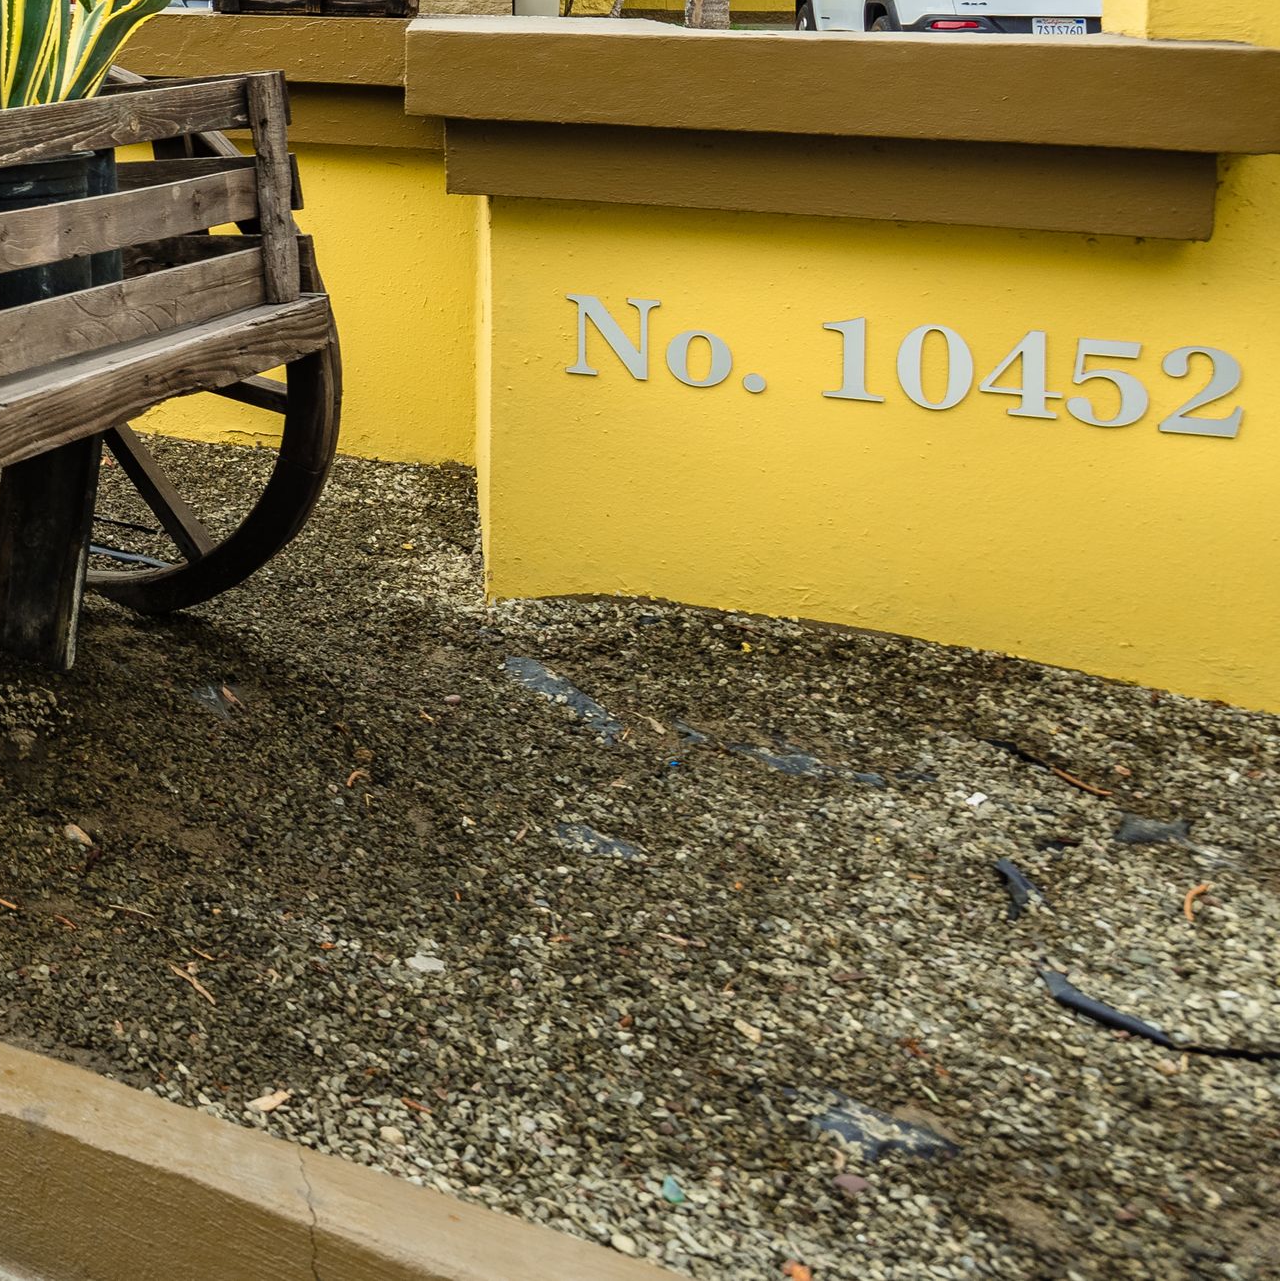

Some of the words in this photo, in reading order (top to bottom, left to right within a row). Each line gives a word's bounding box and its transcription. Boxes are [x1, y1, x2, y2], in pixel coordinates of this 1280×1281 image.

[1036, 25, 1083, 35] 7STS760
[566, 293, 767, 395] No.
[821, 316, 1244, 439] 10452
